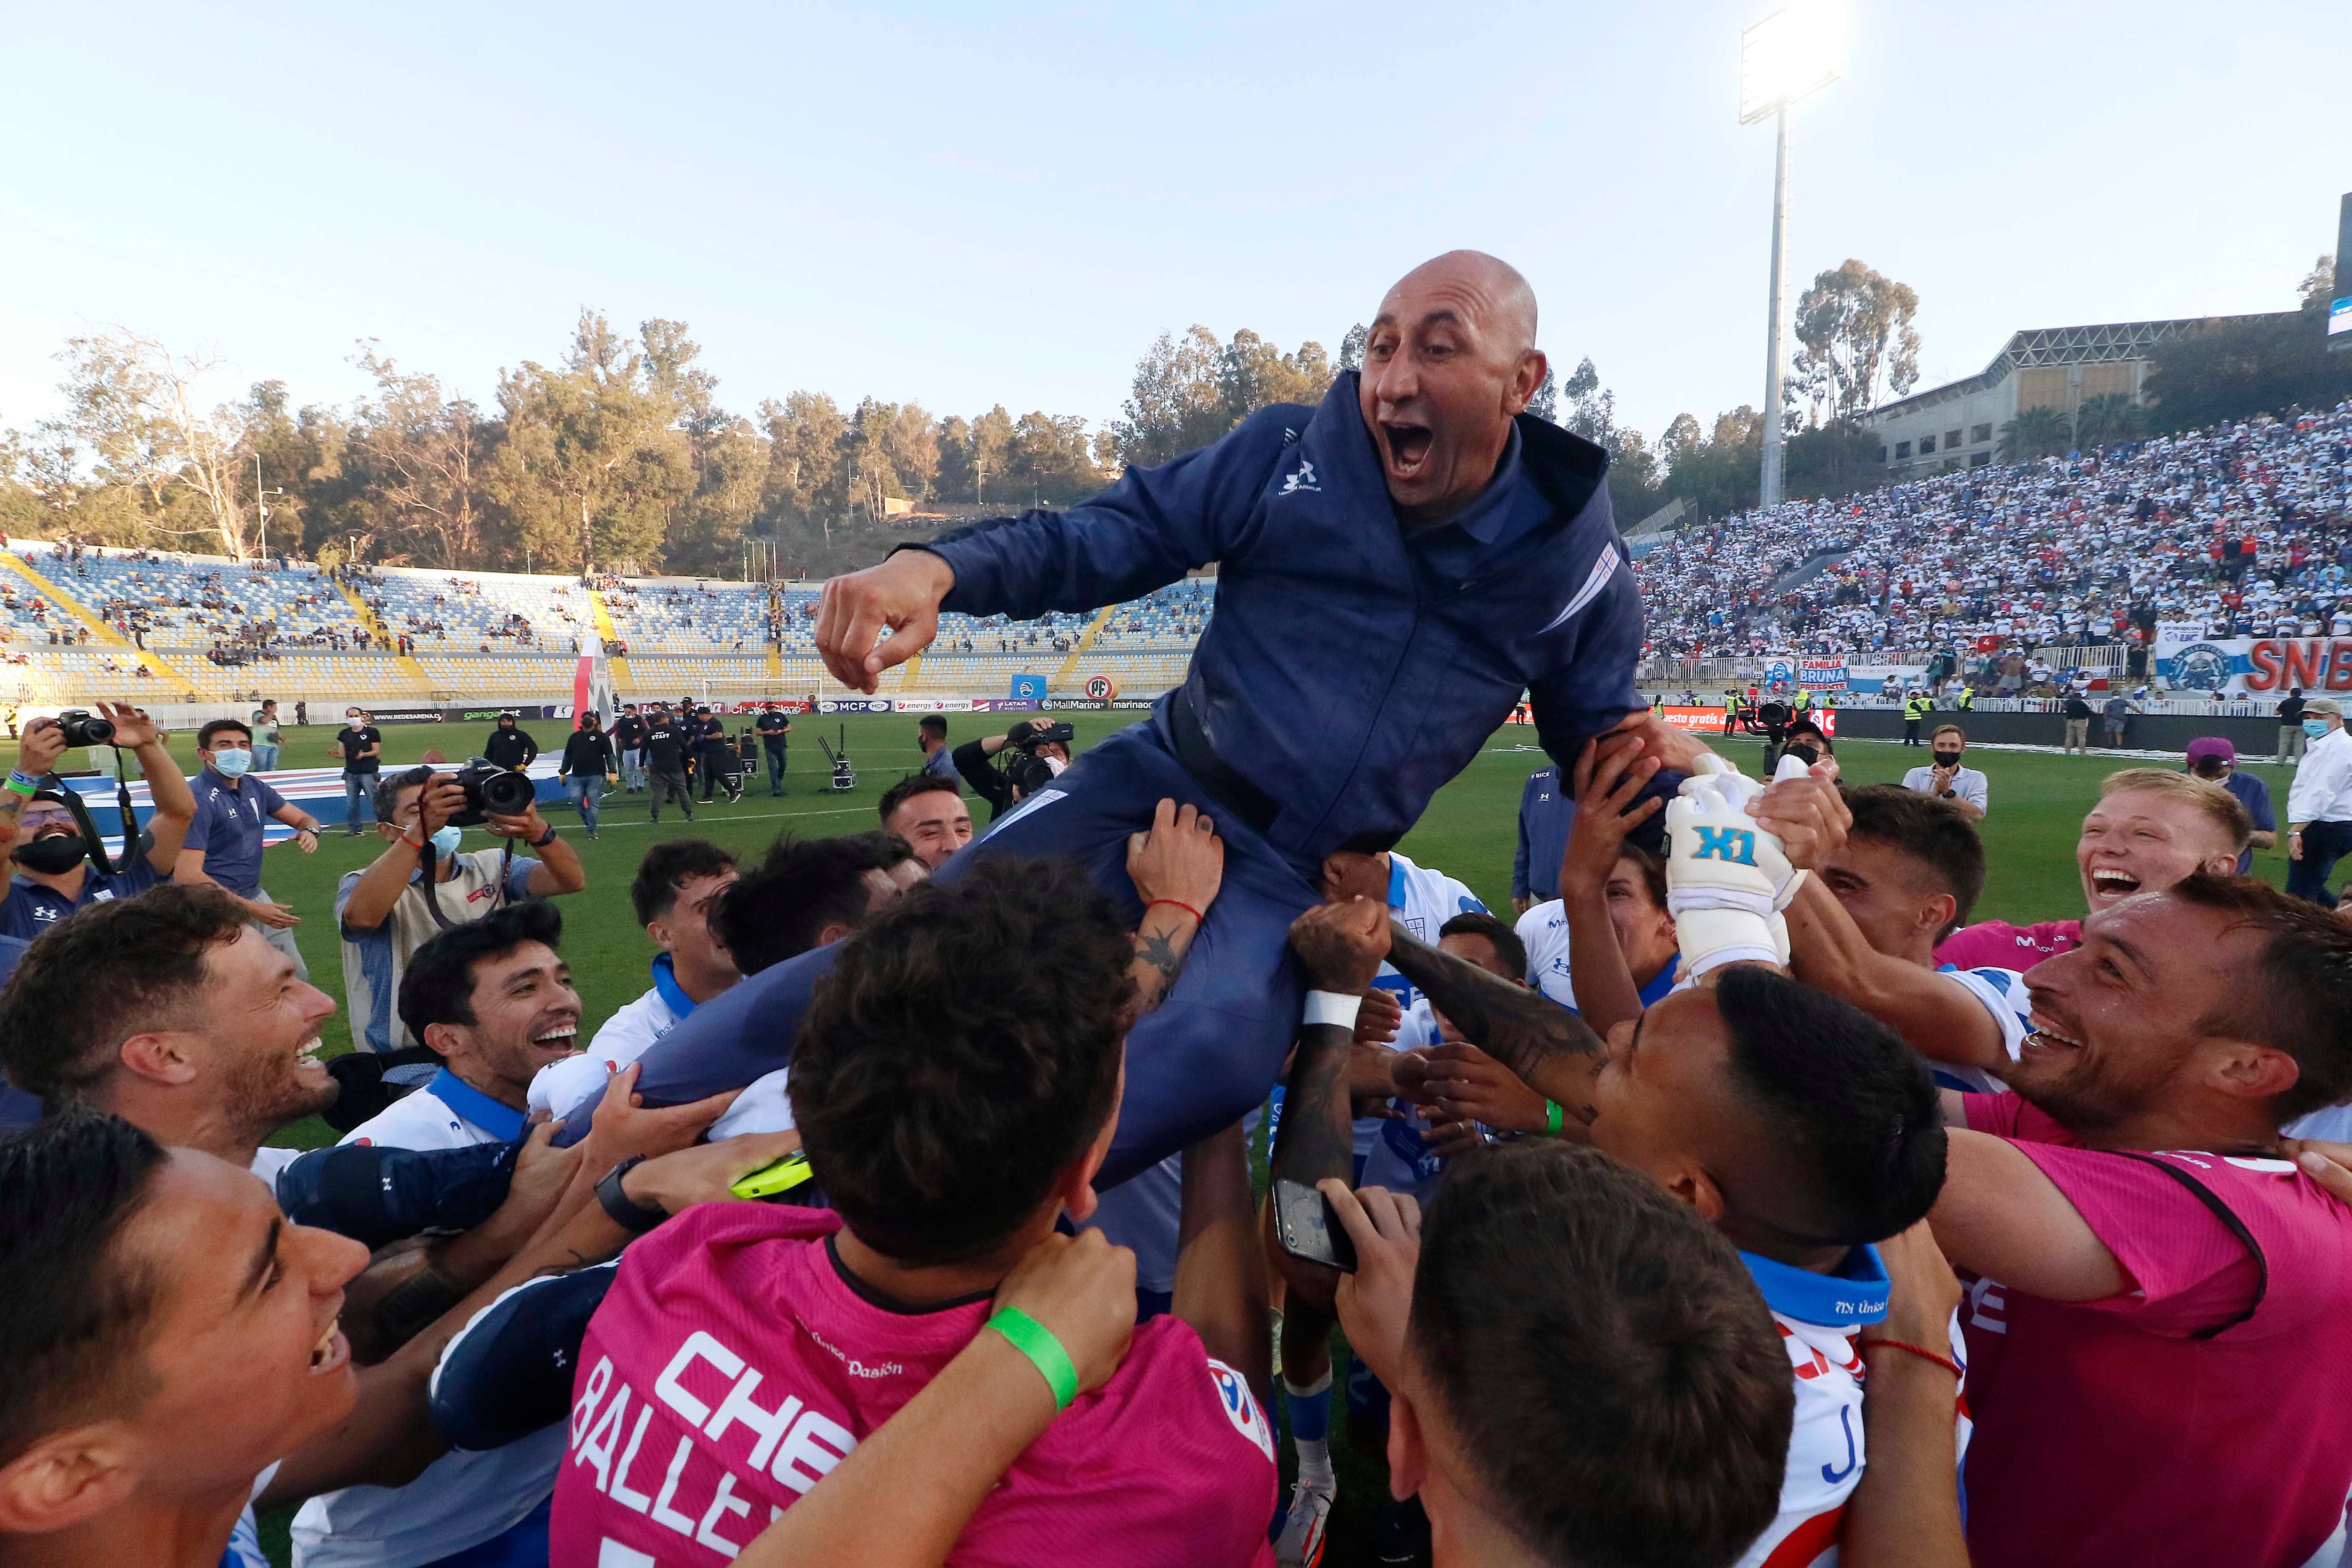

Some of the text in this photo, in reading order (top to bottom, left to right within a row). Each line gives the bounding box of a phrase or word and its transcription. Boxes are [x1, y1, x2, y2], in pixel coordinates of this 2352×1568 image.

[1803, 661, 1842, 669] FAMILIA
[2244, 640, 2352, 691] SNB
[1801, 670, 1845, 683] BRUNA
[1091, 680, 1106, 696] PF
[840, 702, 866, 711] MCP
[464, 709, 521, 720] gangabet
[1688, 713, 1718, 727] gratis
[1691, 827, 1758, 867] X1
[655, 1330, 858, 1496] CHE
[572, 1355, 783, 1559] BALLE
